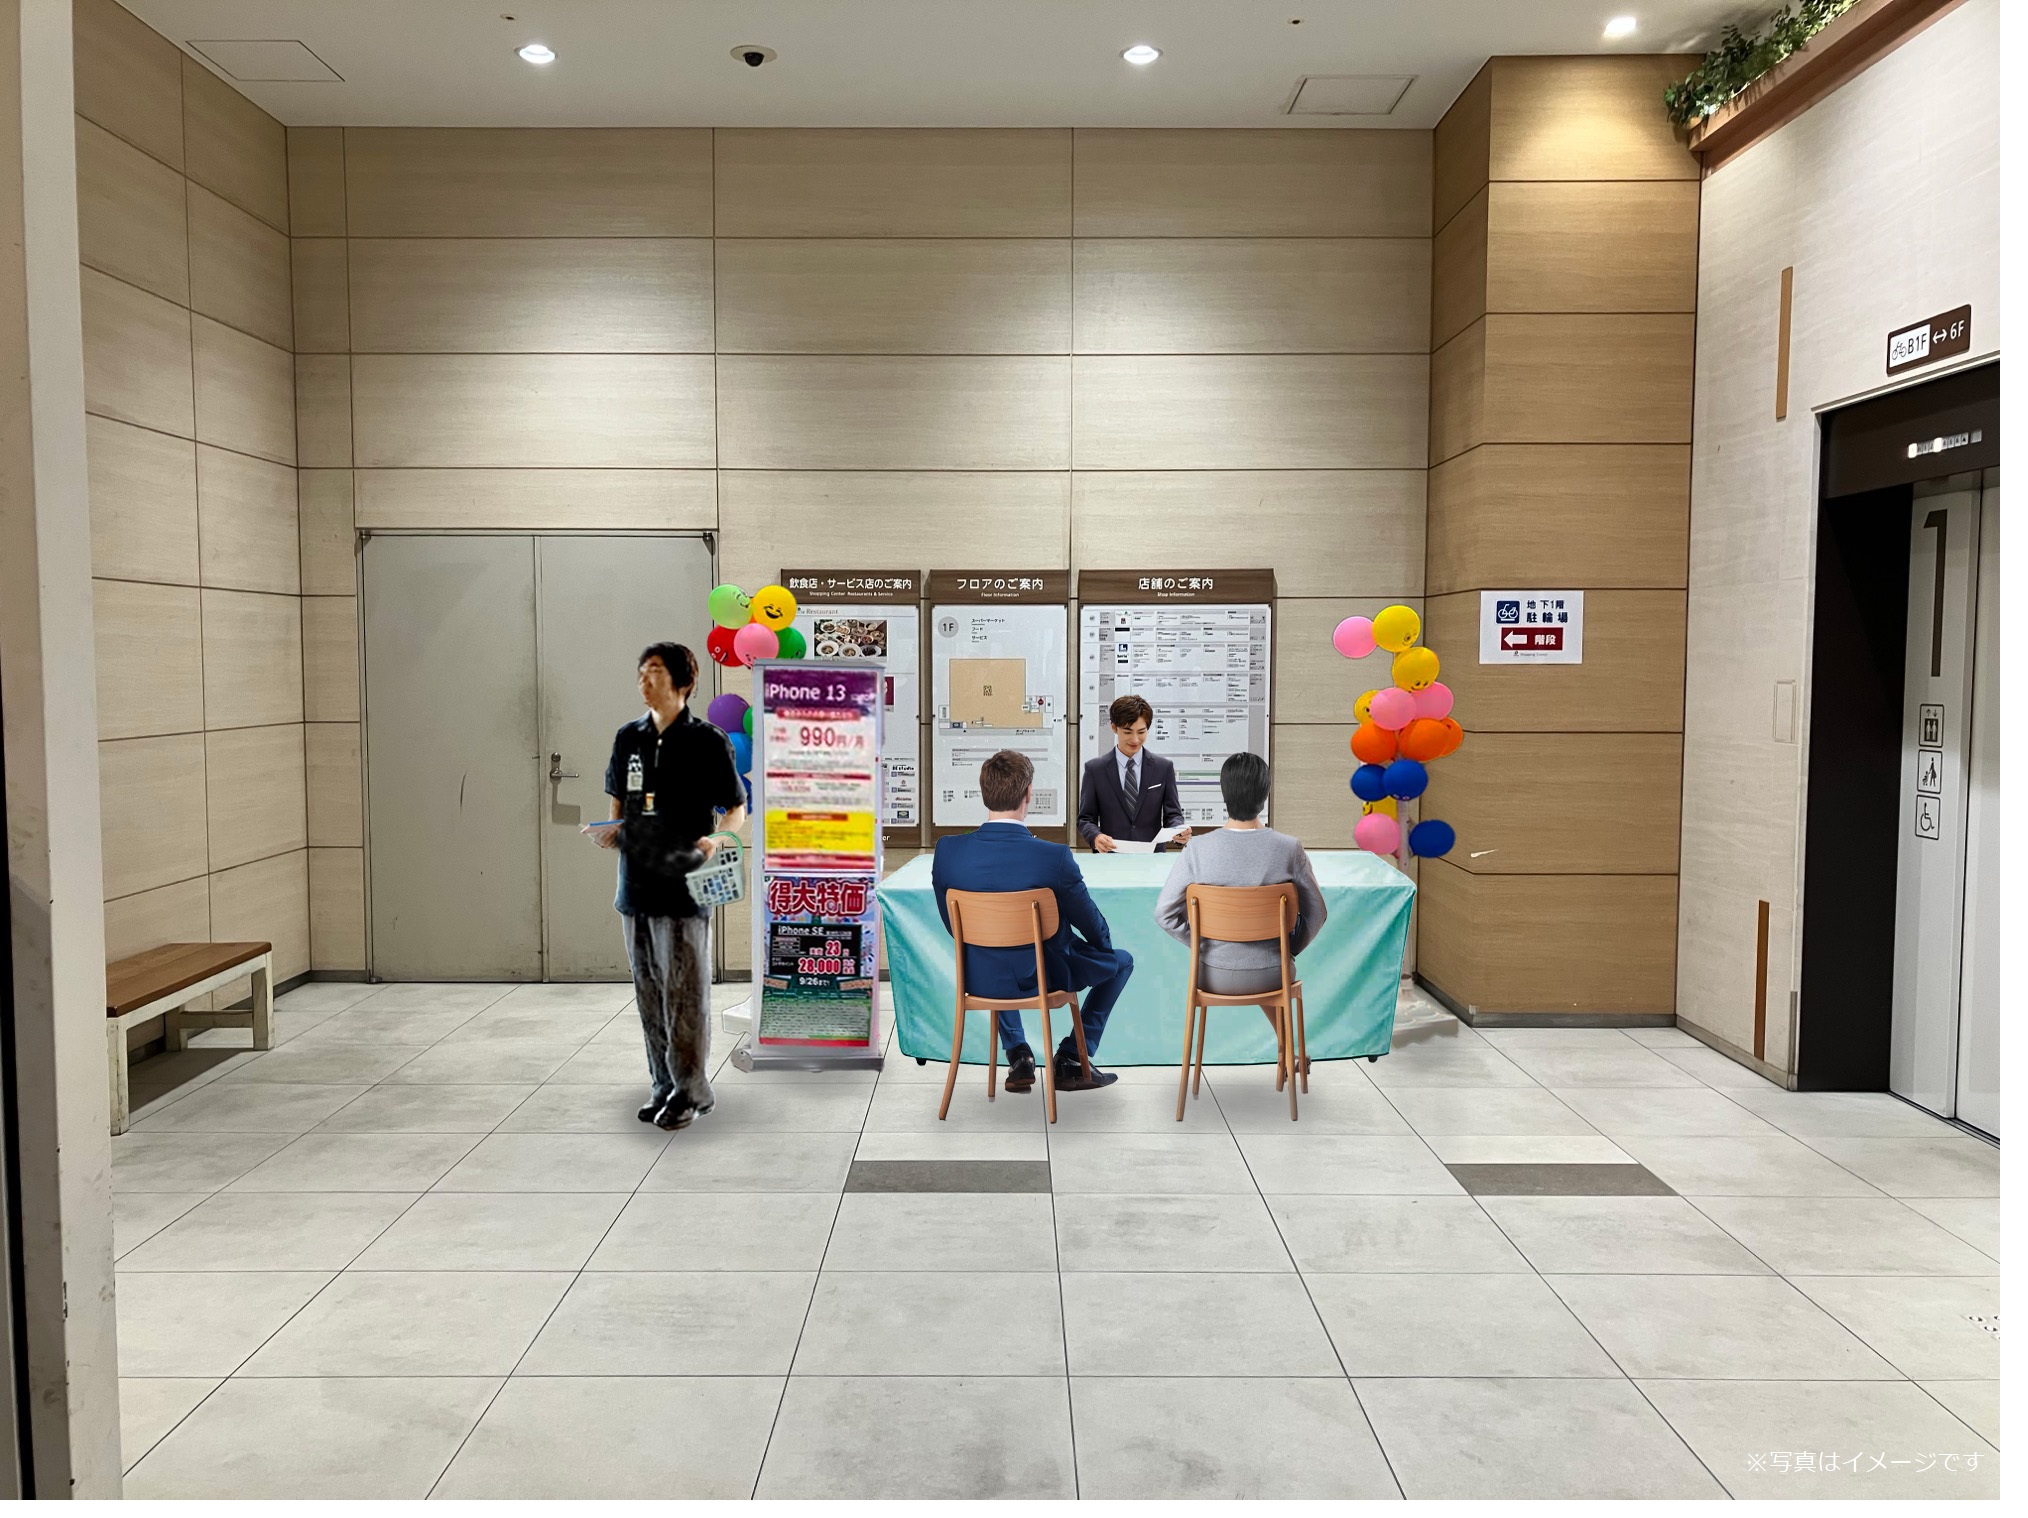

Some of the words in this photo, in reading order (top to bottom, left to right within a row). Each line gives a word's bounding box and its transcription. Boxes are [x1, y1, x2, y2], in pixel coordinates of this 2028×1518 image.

[1907, 332, 1928, 354] B1F
[1950, 319, 1965, 340] 6F
[789, 577, 912, 589] 飲食店・サービス店のご案内
[957, 578, 1044, 590] フロアのご案内
[1138, 577, 1213, 590] 店舗のご案内
[1923, 508, 1948, 677] 1
[1526, 612, 1568, 623] 駐輪場
[943, 622, 954, 632] 1F
[1534, 634, 1556, 646] 階段
[764, 683, 821, 700] iPhone
[826, 684, 846, 701] 13
[769, 880, 867, 916] 得大特価
[778, 926, 810, 935] iPhone
[811, 926, 824, 935] SE
